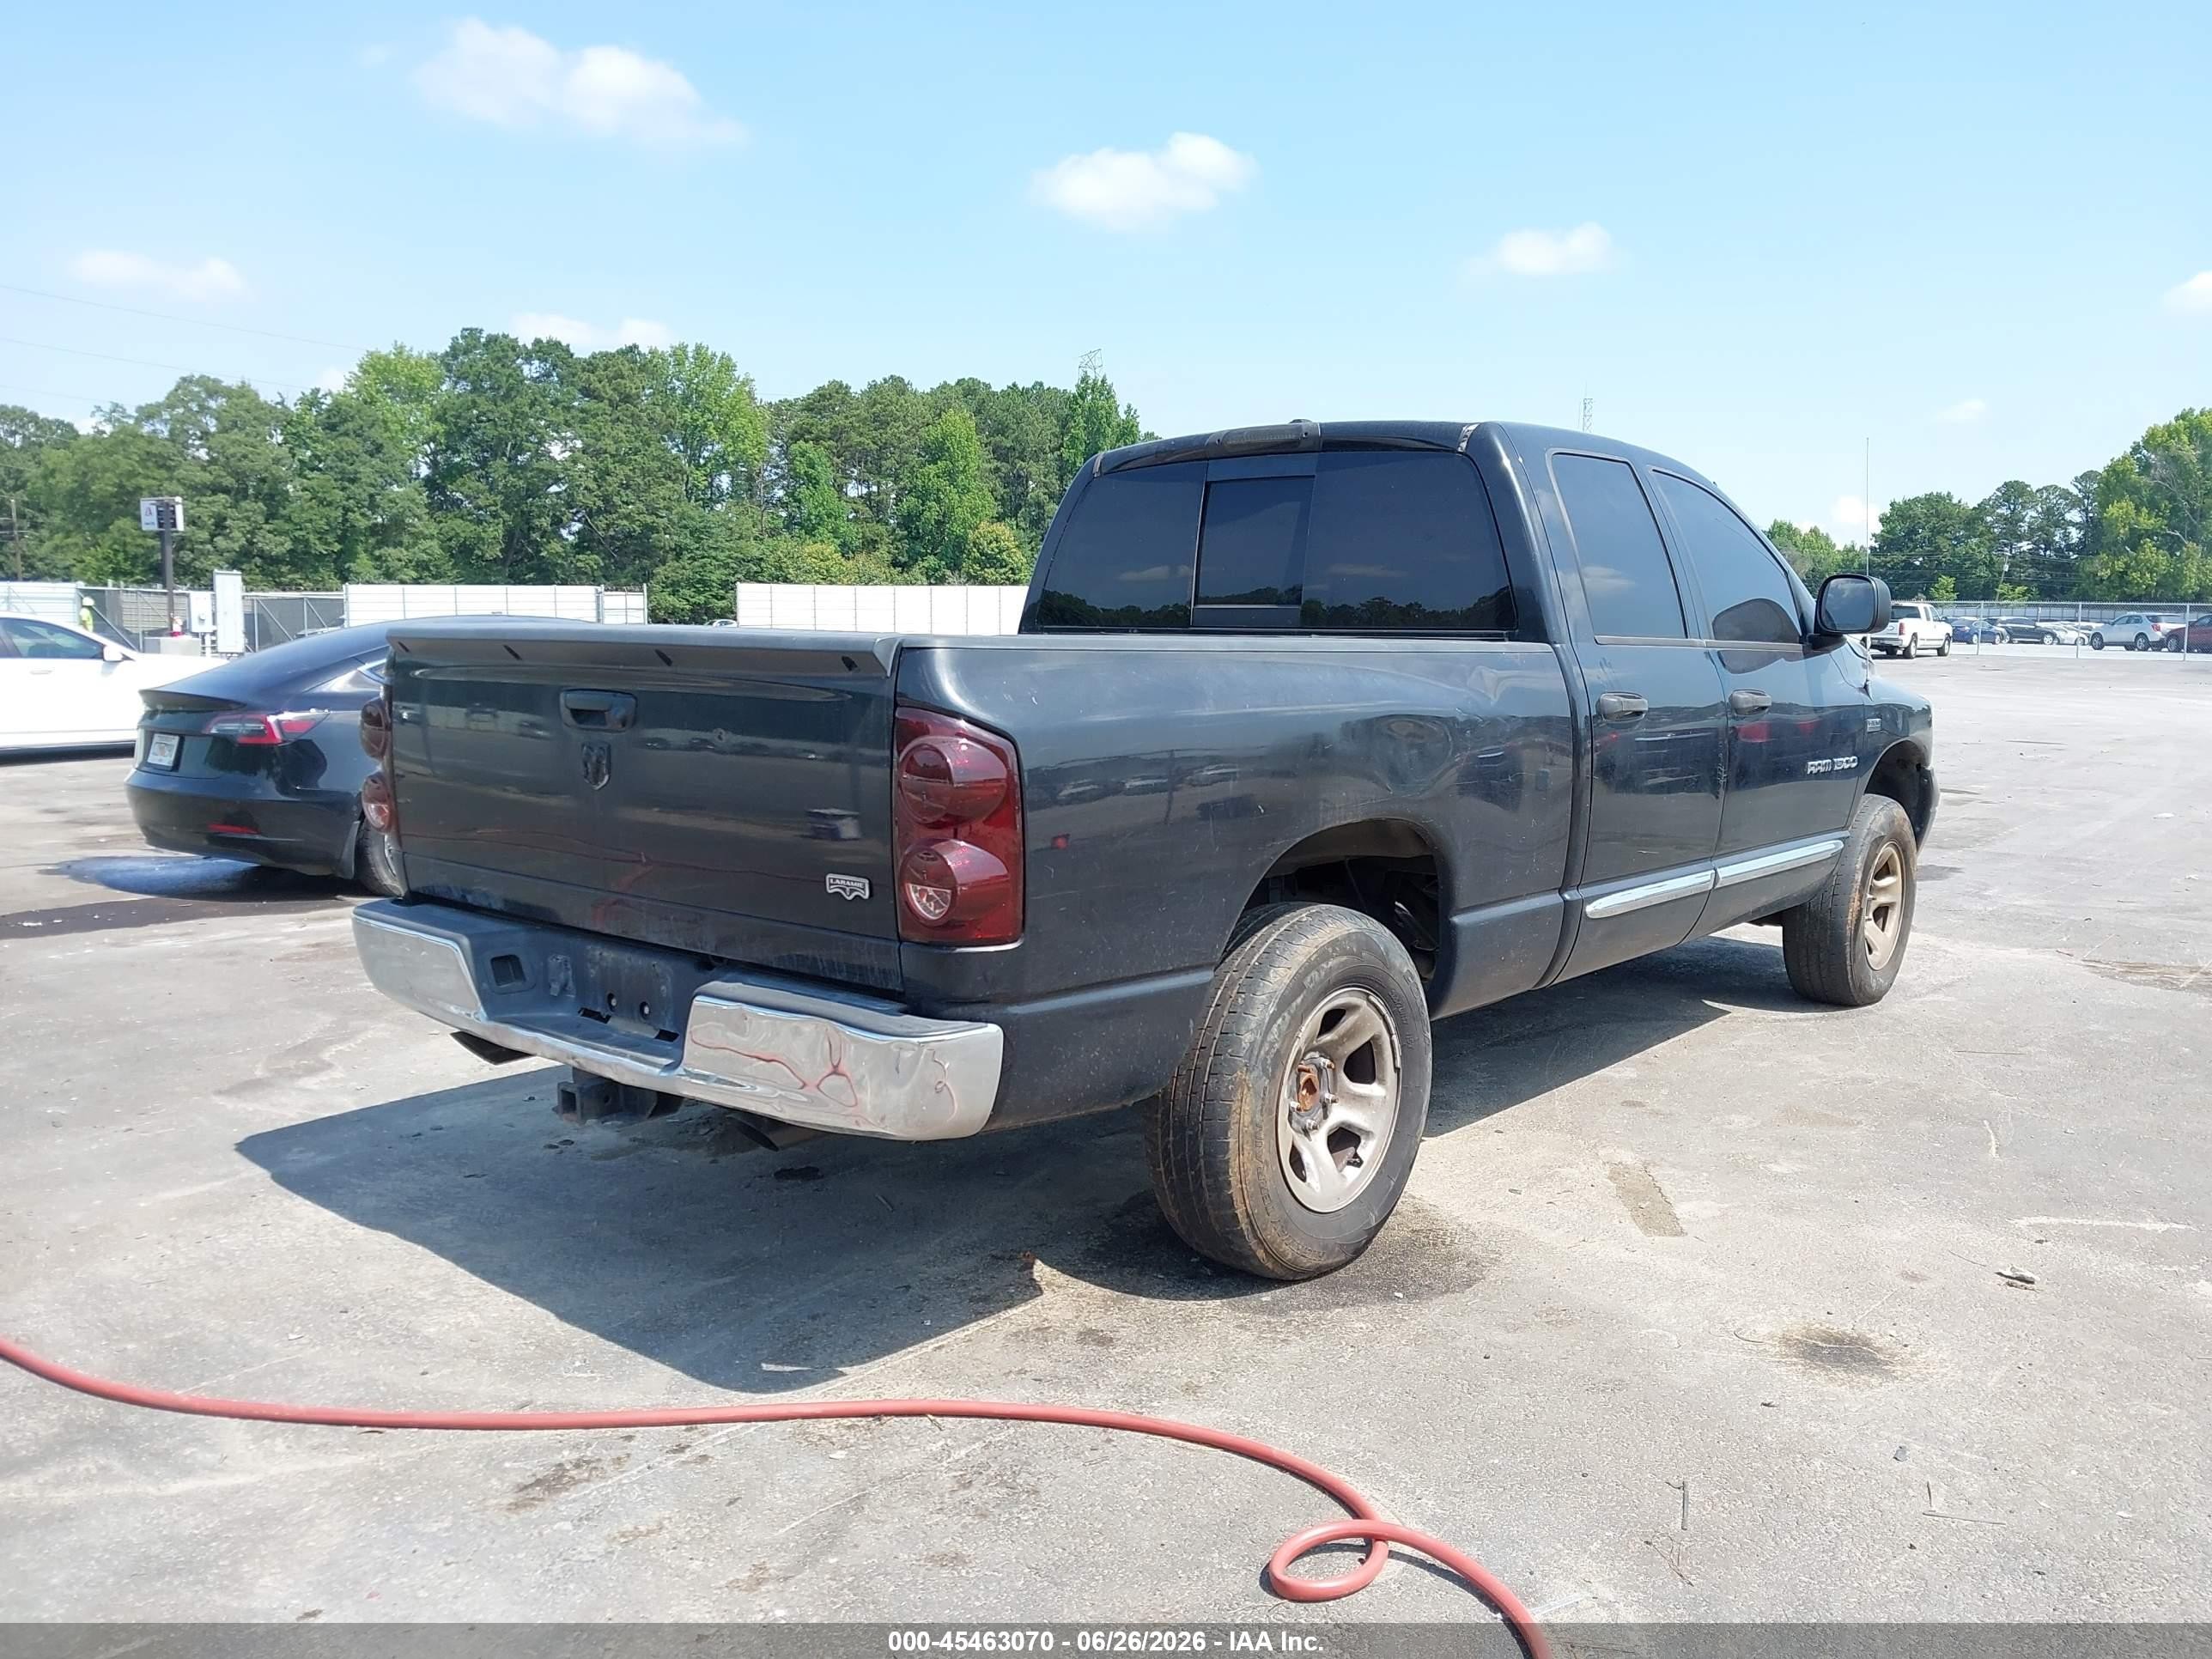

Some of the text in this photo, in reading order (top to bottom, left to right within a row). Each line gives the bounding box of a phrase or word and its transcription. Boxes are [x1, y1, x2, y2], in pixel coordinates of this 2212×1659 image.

[1807, 756, 1858, 775] RAM 1500
[830, 878, 865, 888] LARAMIE
